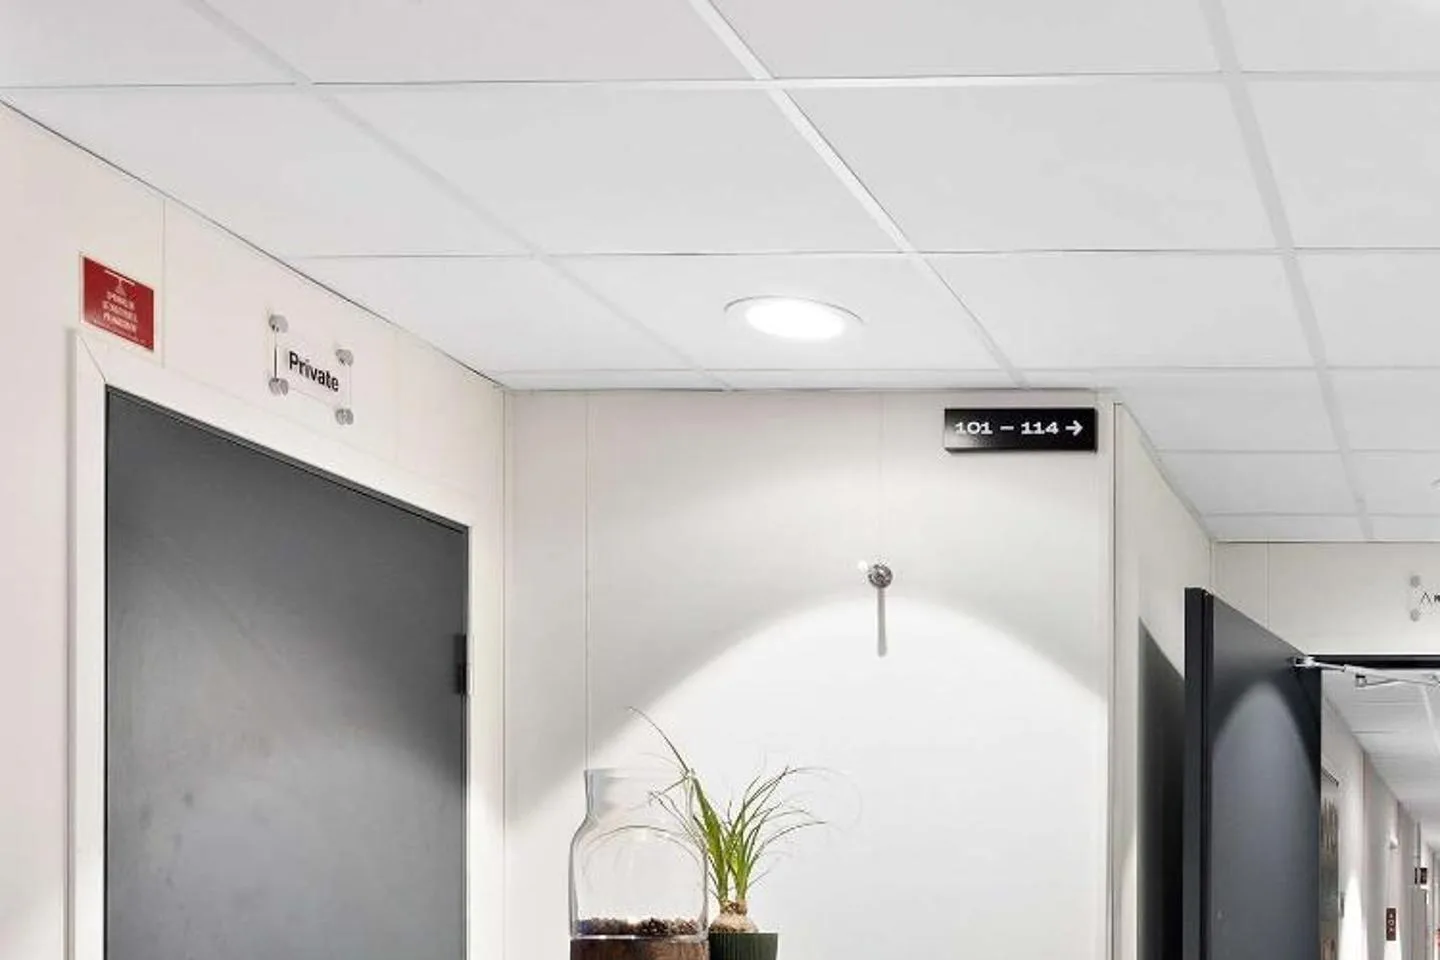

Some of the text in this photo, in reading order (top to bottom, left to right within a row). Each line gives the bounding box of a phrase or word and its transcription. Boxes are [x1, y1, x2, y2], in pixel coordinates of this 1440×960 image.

[288, 350, 339, 393] Private
[954, 421, 994, 435] 101
[1020, 421, 1060, 435] 114
